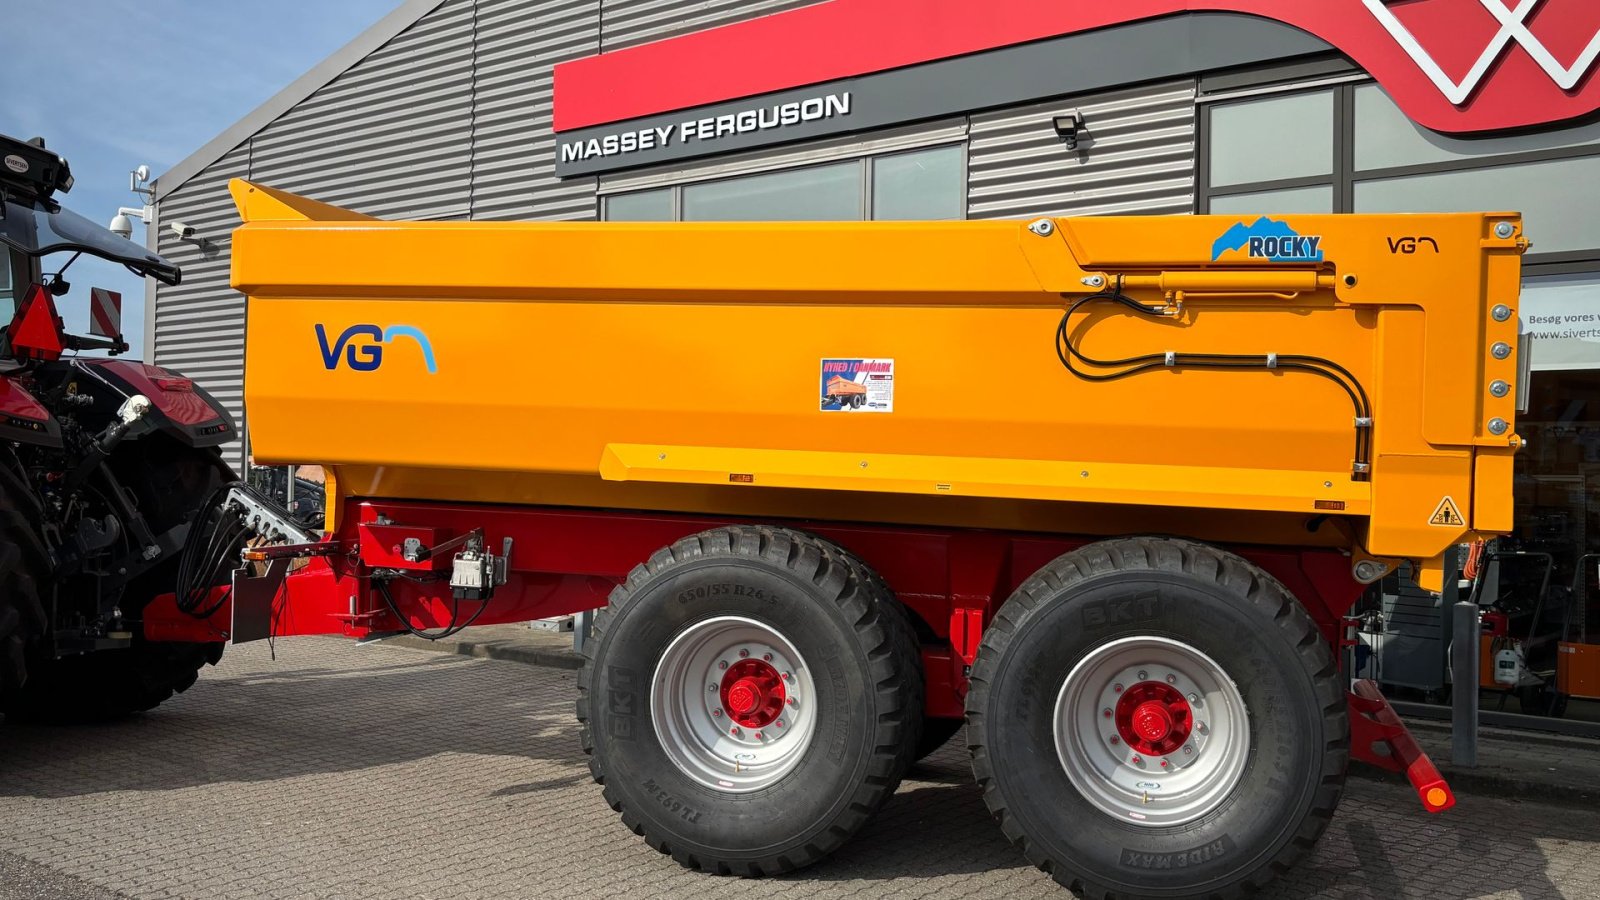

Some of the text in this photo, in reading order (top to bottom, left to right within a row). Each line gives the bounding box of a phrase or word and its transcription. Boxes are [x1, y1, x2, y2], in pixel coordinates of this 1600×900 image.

[562, 92, 850, 162] MASSEY FERGUSON
[1248, 236, 1321, 257] ROCKY
[1529, 315, 1561, 325] Besøg
[1564, 314, 1595, 323] vores
[678, 583, 731, 604] 650/55
[1082, 592, 1159, 627] BKT
[611, 667, 634, 739] BKT
[1126, 840, 1225, 869] RIDE MAX
